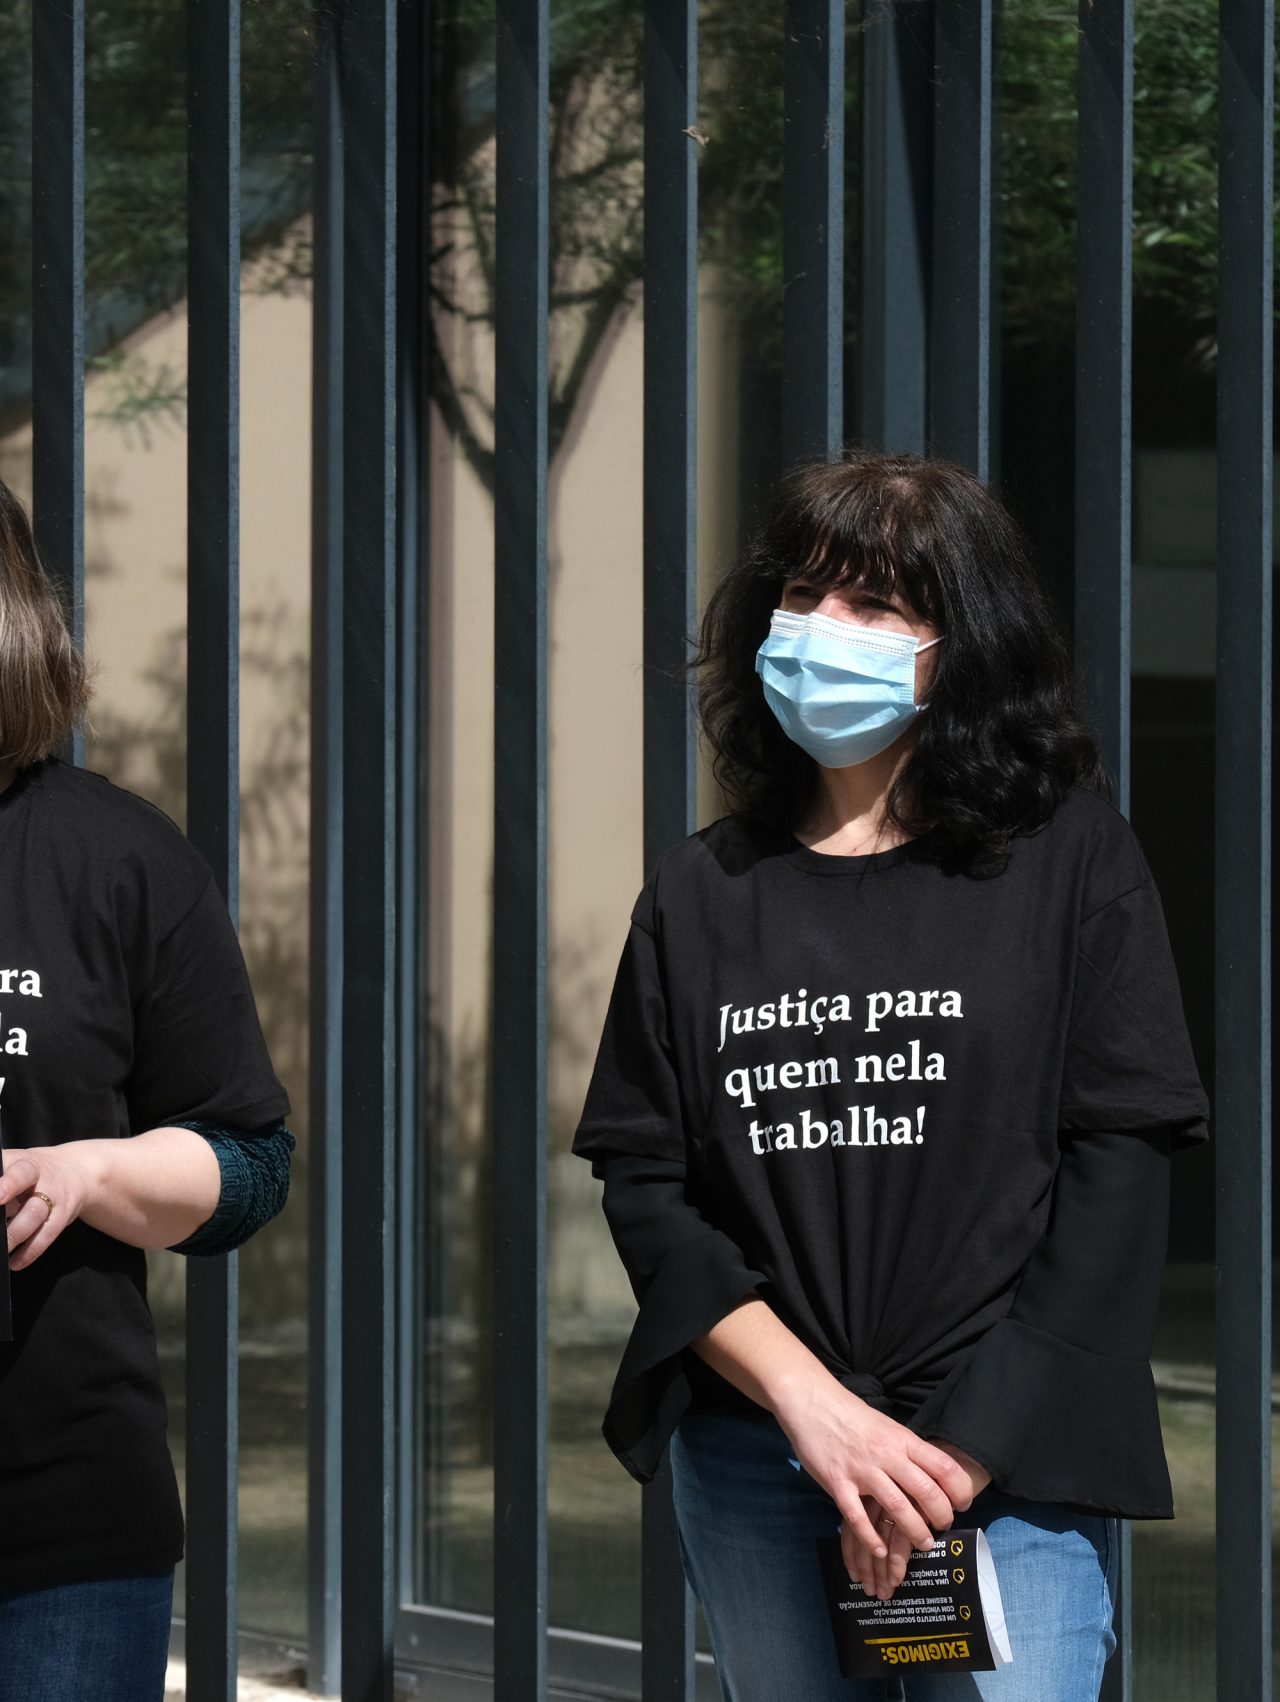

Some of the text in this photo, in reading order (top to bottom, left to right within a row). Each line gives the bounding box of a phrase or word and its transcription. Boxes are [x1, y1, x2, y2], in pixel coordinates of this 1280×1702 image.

[717, 988, 964, 1053] Justiça para
[724, 1039, 947, 1108] quem nela
[748, 1105, 926, 1155] trabalha!
[909, 1570, 937, 1579] FUNÇÕES.
[911, 1579, 935, 1587] TABELA
[892, 1598, 925, 1606] ESPECÍFICO
[873, 1607, 906, 1617] NOMEAÇÃO
[915, 1606, 941, 1615] VÍNCULO
[857, 1616, 916, 1626] SOCIOPROFISSIONAL
[917, 1615, 946, 1623] ESTATUTO
[881, 1640, 970, 1665] EXIGIMOS:
